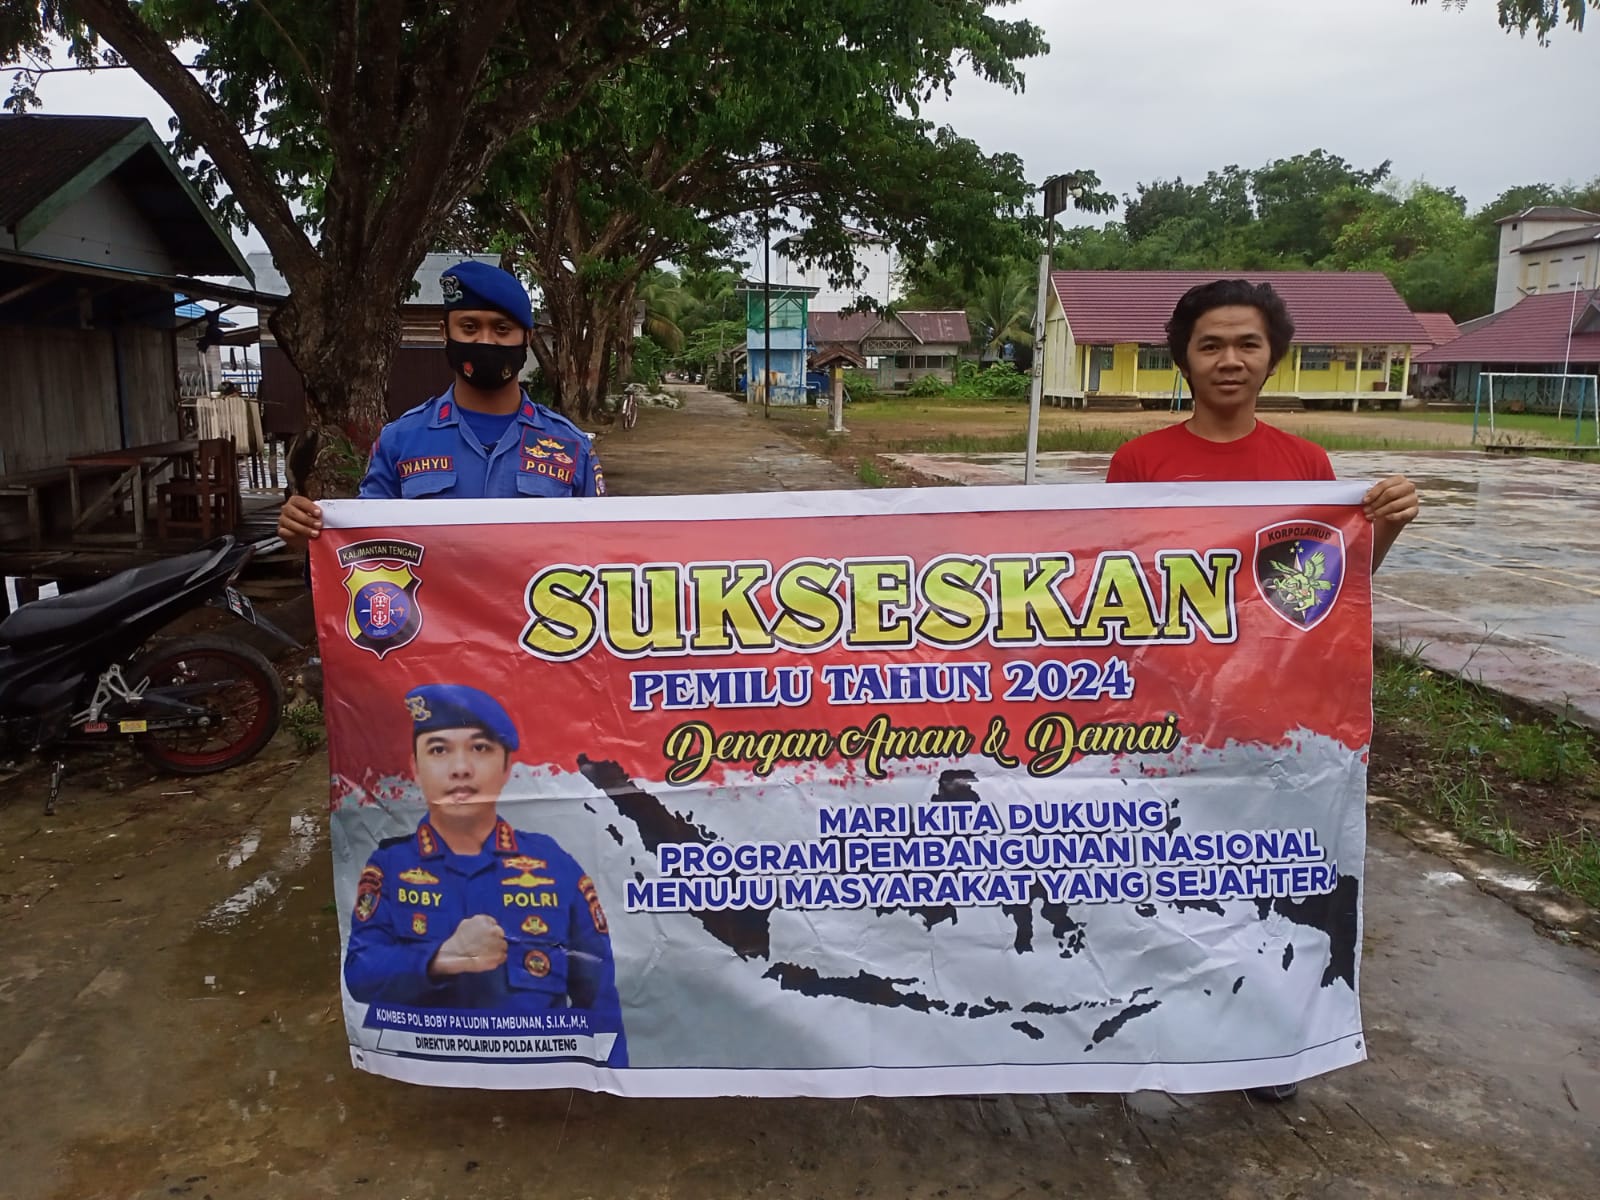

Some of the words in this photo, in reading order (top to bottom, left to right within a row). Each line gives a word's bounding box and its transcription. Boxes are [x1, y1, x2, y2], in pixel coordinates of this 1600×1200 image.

[402, 457, 449, 475] WAHYU
[525, 460, 570, 482] POLRI
[1267, 527, 1332, 541] KORPOLAIRUD
[342, 545, 387, 561] KALIMANTAN
[388, 545, 418, 560] TENGAH
[523, 553, 1237, 656] SUKSESKAN
[632, 668, 811, 708] PEMILU
[824, 665, 991, 700] TAHUN
[1005, 659, 1132, 698] 2024
[666, 723, 833, 784] Dengan
[839, 717, 970, 776] Aman
[983, 718, 1016, 765] &
[1028, 714, 1179, 775] Damai
[820, 807, 905, 833] MARI
[919, 804, 998, 831] KITA
[1009, 801, 1163, 829] DUKUNG
[660, 844, 837, 873] PROGRAM
[851, 836, 1131, 869] PEMBANGUNAN
[1142, 832, 1320, 863] NASIONAL
[398, 888, 442, 907] BOBY
[503, 892, 558, 908] POLRI
[627, 879, 774, 908] MENUJU
[785, 875, 1032, 905] MASYARAKAT
[1040, 872, 1144, 900] YANG
[376, 1007, 406, 1025] KOMBES
[407, 1013, 423, 1027] POL
[424, 1014, 447, 1028] BOBY
[491, 1016, 545, 1030] TAMBUNAN,
[415, 1036, 456, 1051] DIREKTUR
[457, 1039, 501, 1052] POLAIRUD
[503, 1039, 533, 1053] POLDA
[535, 1038, 577, 1052] KALTENG
